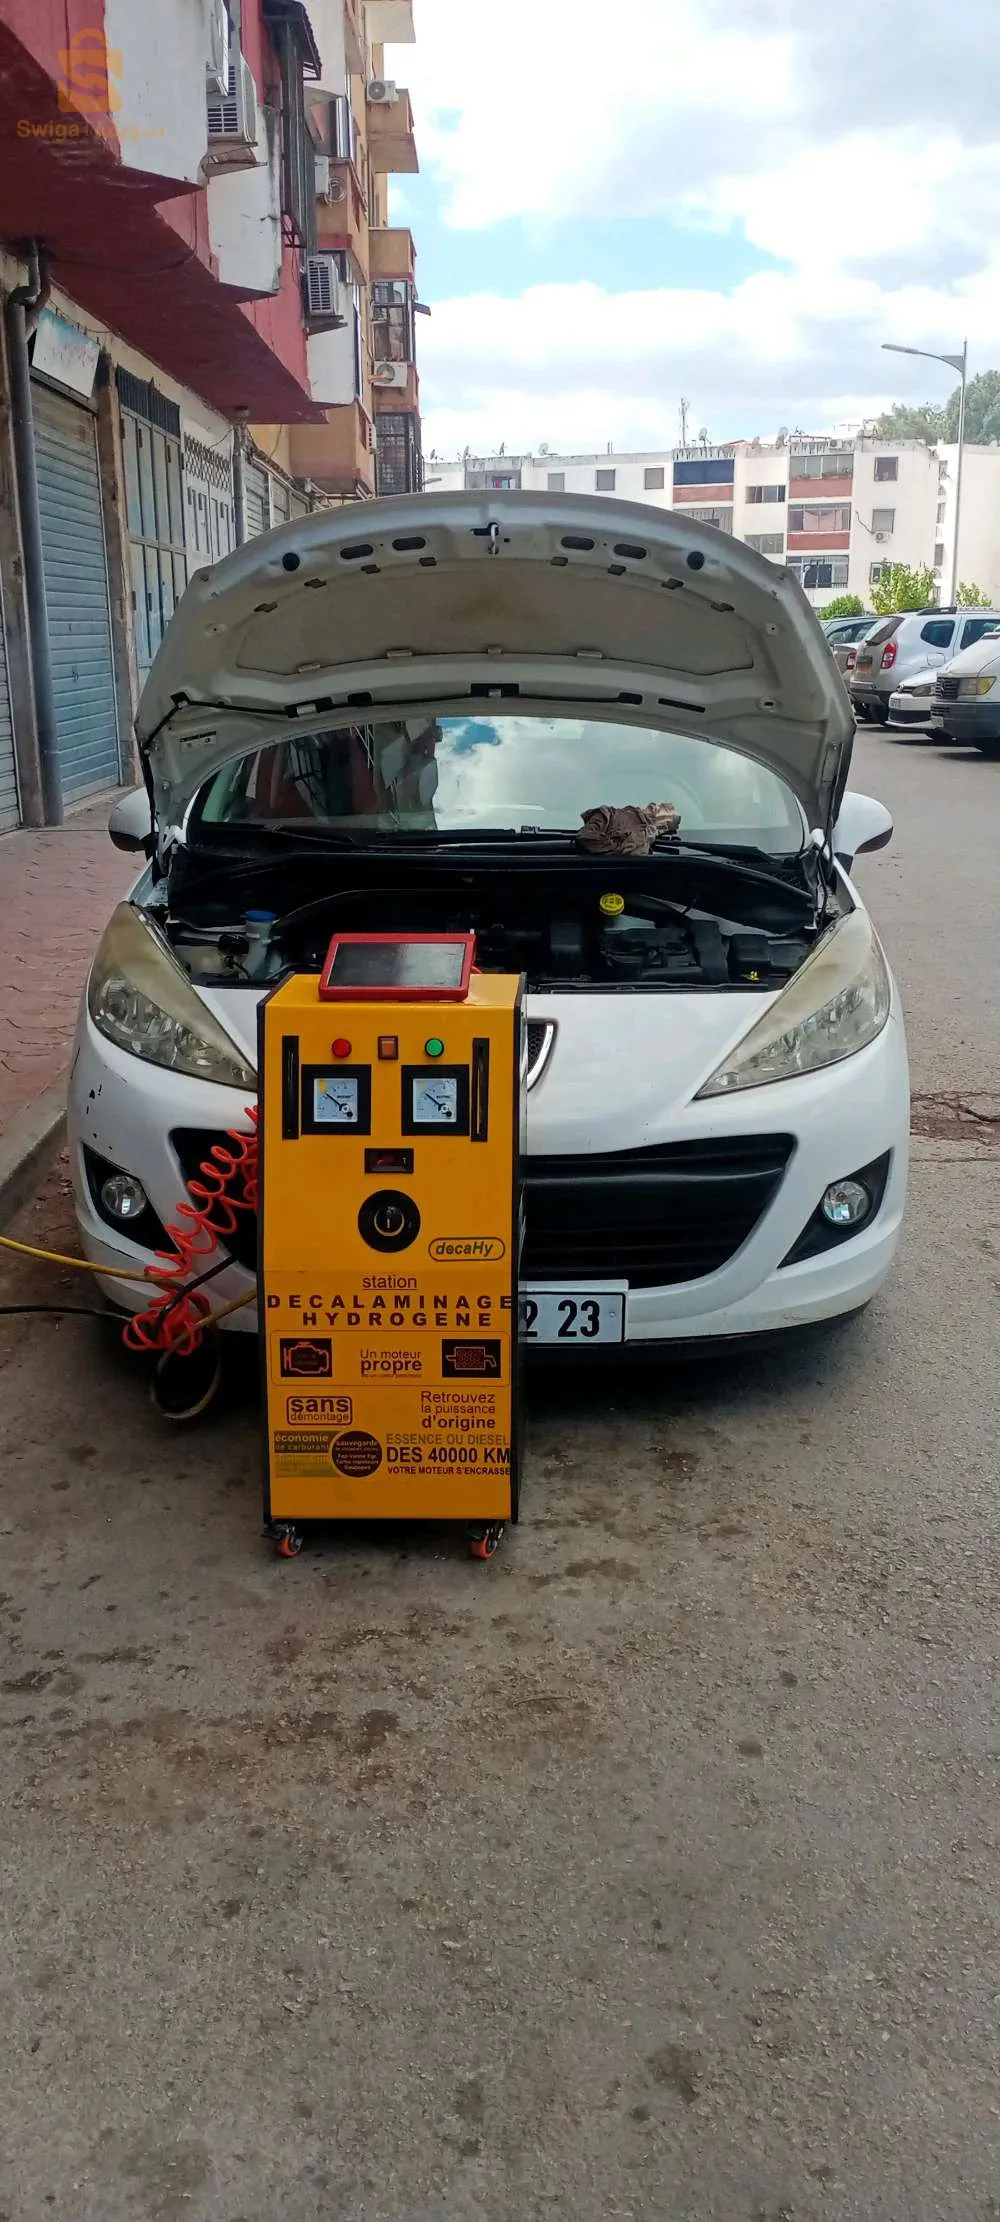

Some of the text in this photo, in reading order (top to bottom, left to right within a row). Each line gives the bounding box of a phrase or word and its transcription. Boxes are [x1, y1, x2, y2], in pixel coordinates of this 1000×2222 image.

[435, 1241, 493, 1257] decaHy
[362, 1275, 418, 1290] station
[268, 1295, 512, 1309] DECALAMINAGE
[303, 1312, 491, 1326] HYDROGENE
[558, 1299, 600, 1337] 23
[360, 1348, 422, 1359] Un moteur
[361, 1360, 422, 1374] propre
[421, 1391, 495, 1404] Retrouvez
[291, 1399, 349, 1412] sans
[421, 1403, 496, 1416] la puissance
[422, 1416, 496, 1431] d'origine
[275, 1432, 329, 1442] économie
[386, 1434, 511, 1446] ESSENCE OU DIESEL
[386, 1447, 422, 1462] DES
[428, 1447, 477, 1463] 40000
[484, 1448, 510, 1463] KM
[419, 1467, 454, 1475] MOTEUR
